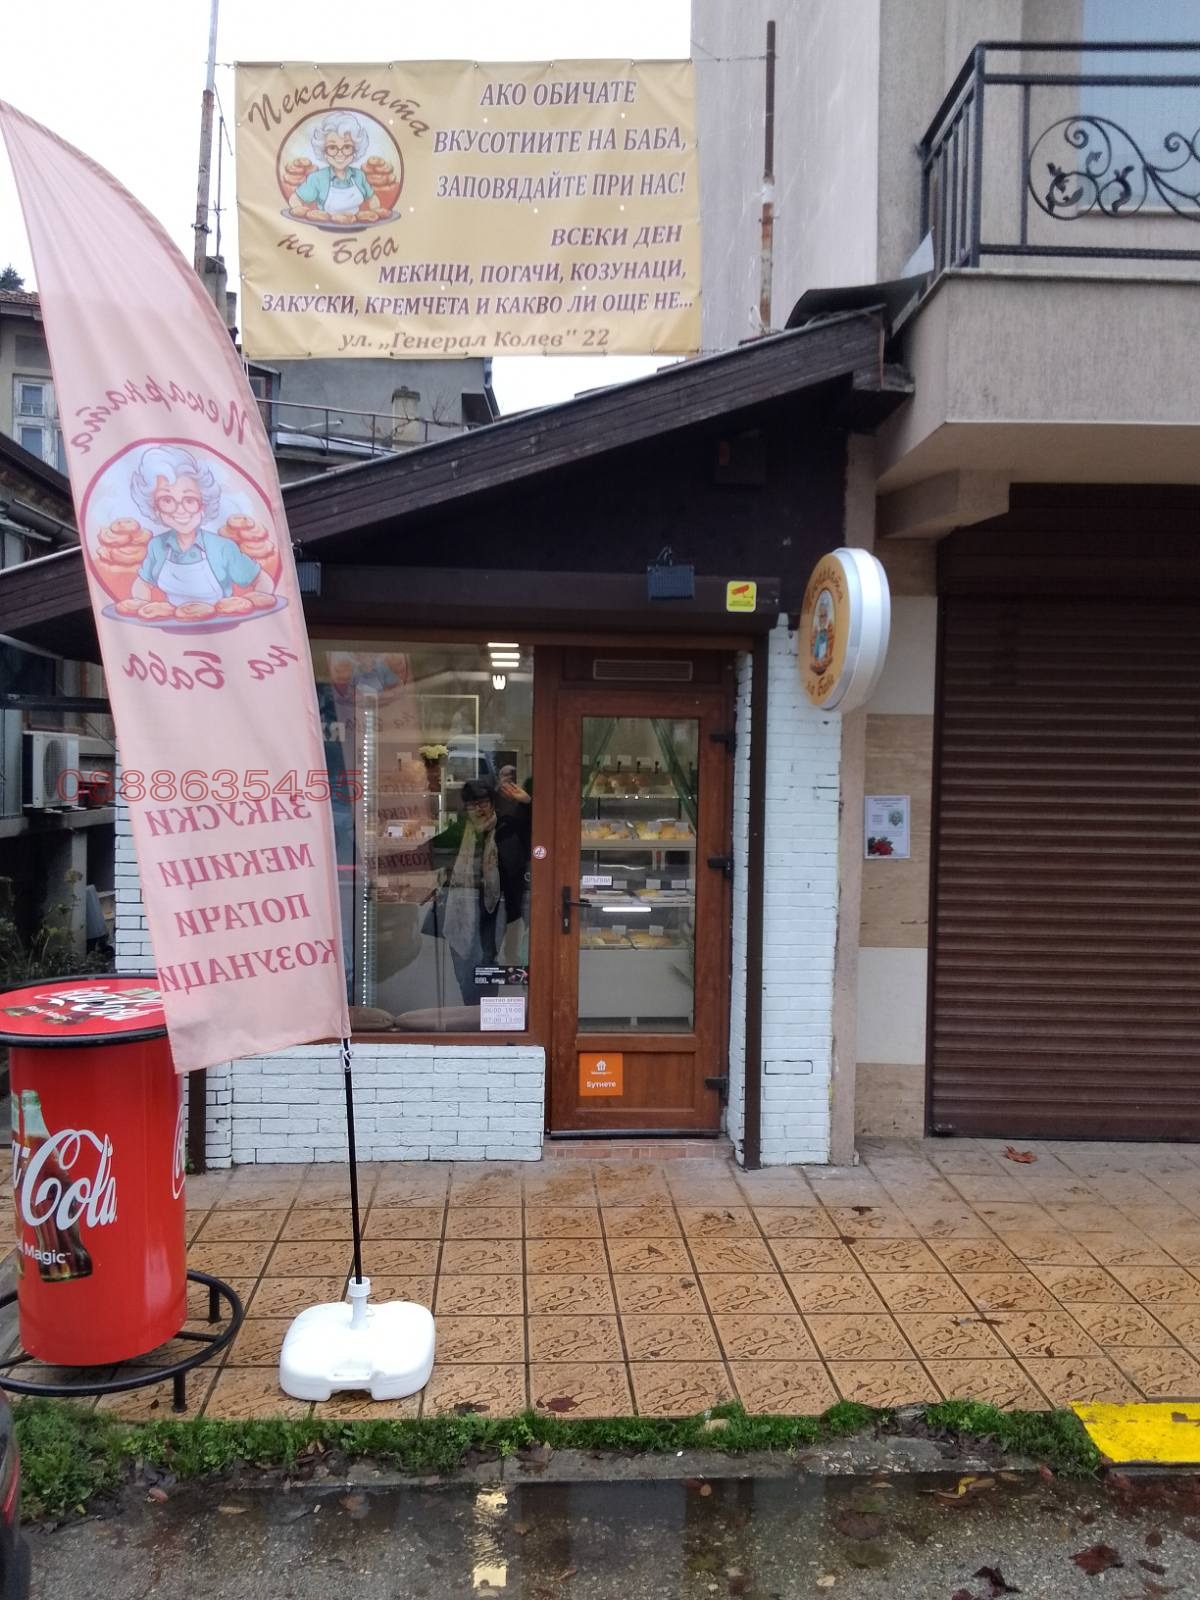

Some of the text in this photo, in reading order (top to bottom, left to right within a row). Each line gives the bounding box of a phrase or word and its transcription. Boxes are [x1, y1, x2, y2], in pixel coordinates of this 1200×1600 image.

[248, 76, 430, 137] Пекарната
[480, 80, 637, 106] АКО ОБИЧАТЕ
[433, 126, 687, 154] ВКУСОТИИТЕ НА БАБА,
[436, 170, 686, 204] ЗАПОВЯДАЙТЕ ПРИ НАС!
[278, 233, 399, 265] на Баба
[550, 225, 683, 248] ВСЕКИ ДЕН
[378, 259, 687, 287] МЕКИЦИ, ПОГАЧИ, КОЗУНАЦИ,
[261, 291, 693, 317] ЗАКУСКИ, КРЕМЧЕТА И КАКВО ЛИ ОЩЕ НЕ...
[338, 333, 372, 351] ул.
[582, 328, 610, 347] 22
